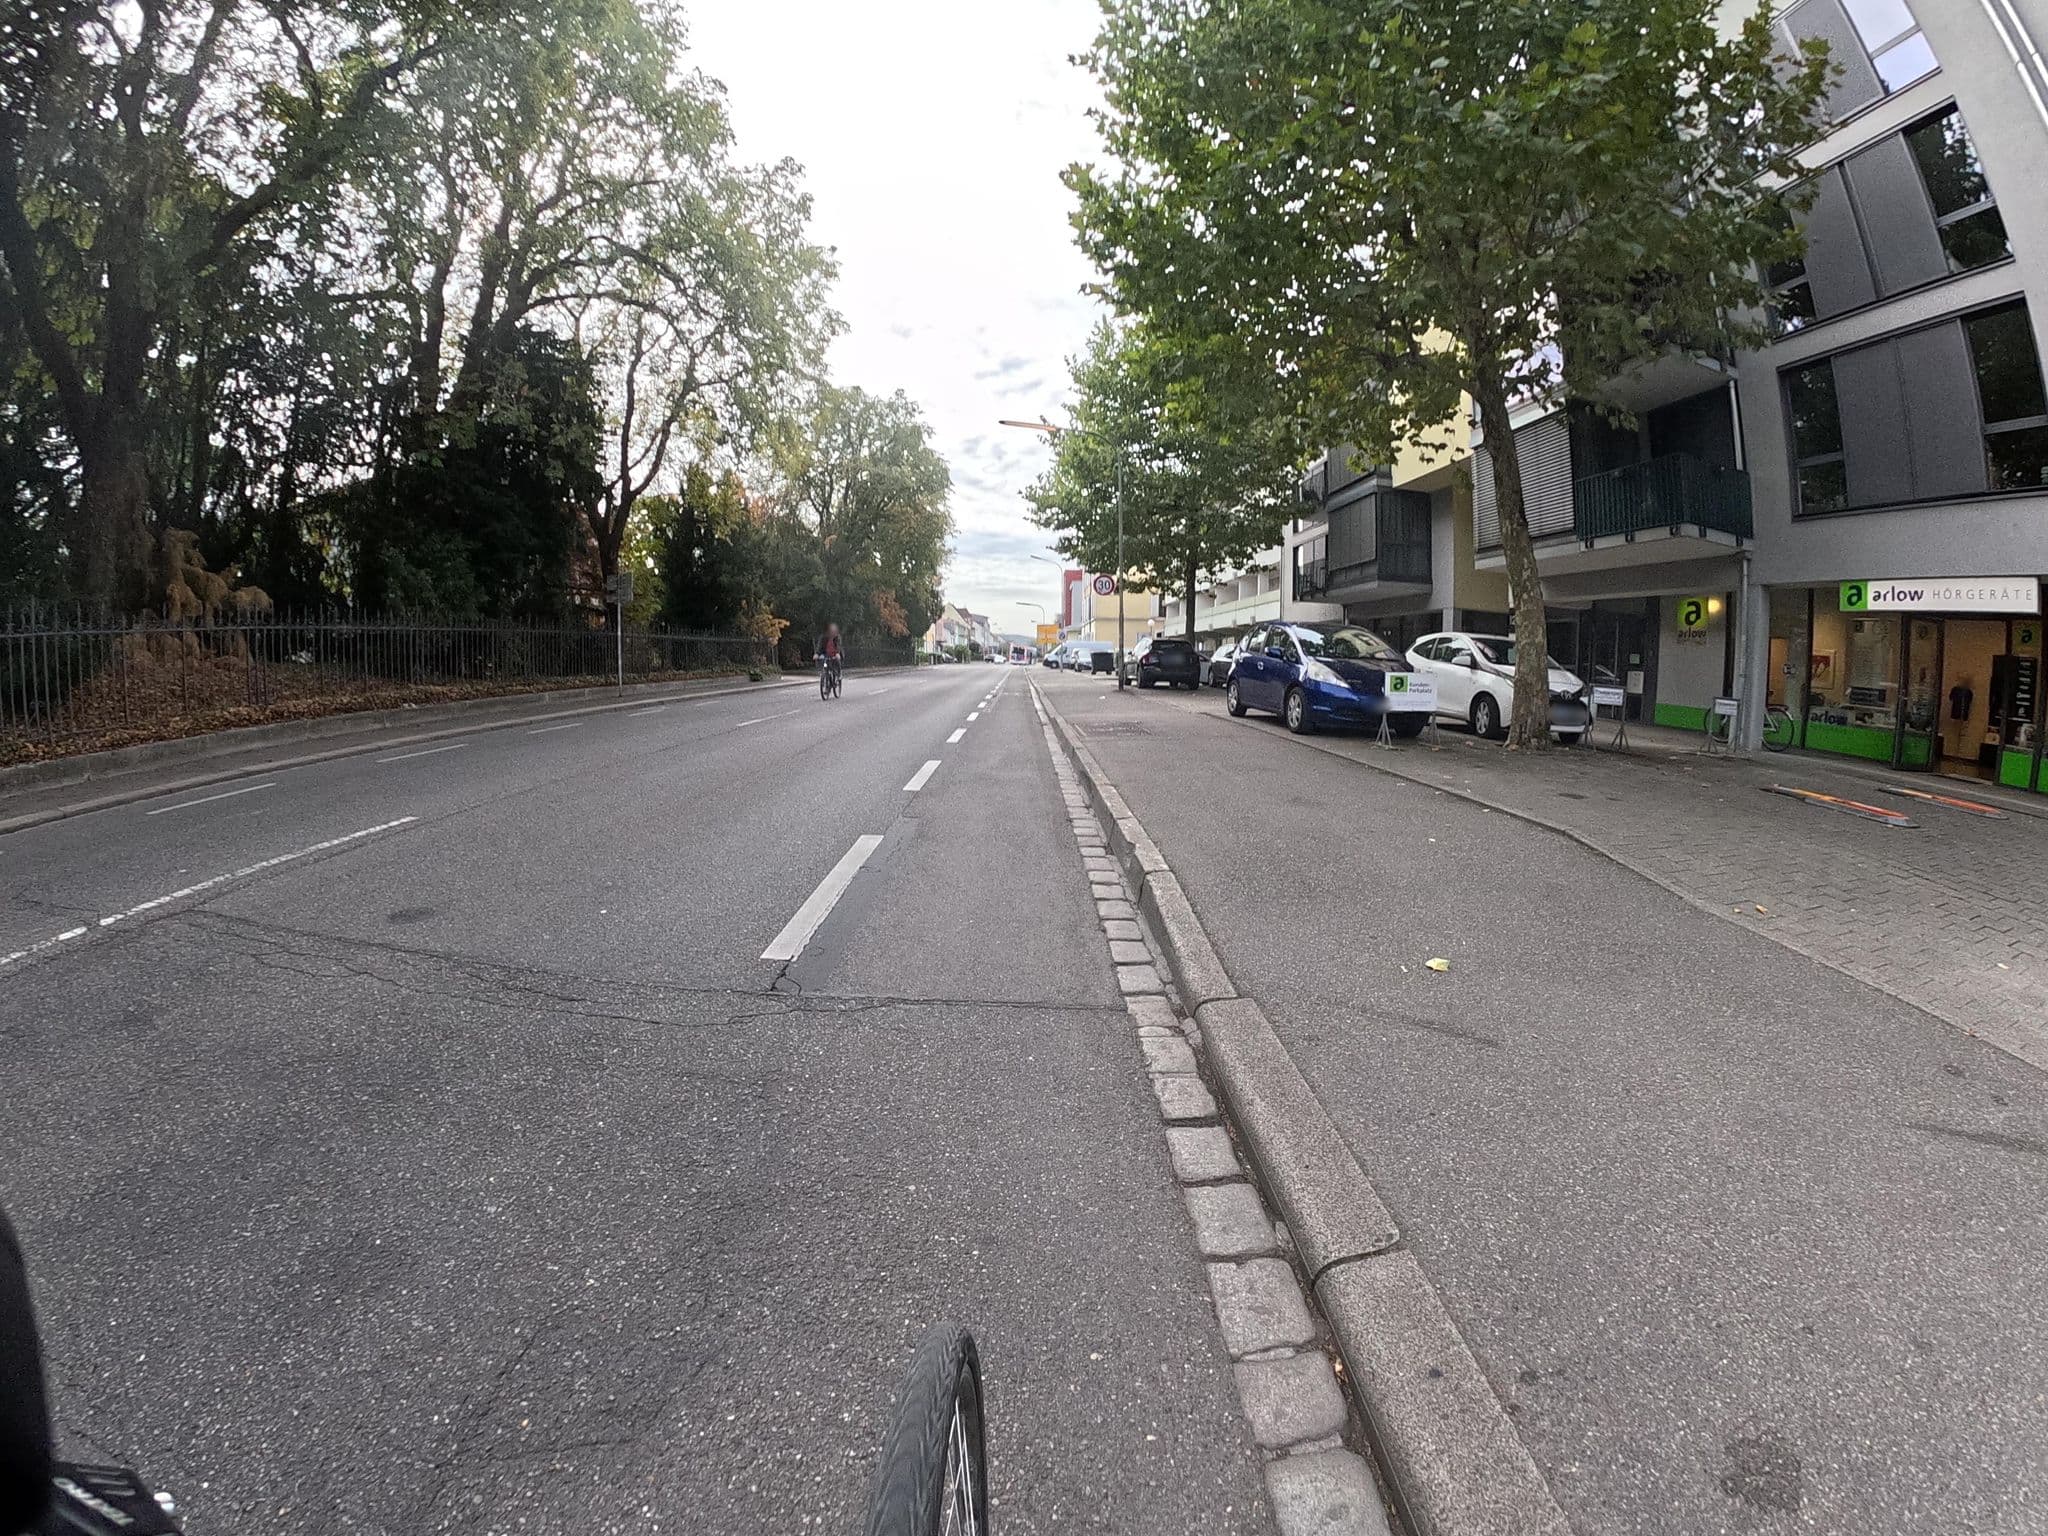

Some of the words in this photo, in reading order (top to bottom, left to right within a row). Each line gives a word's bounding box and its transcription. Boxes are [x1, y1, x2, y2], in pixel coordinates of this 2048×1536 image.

[1098, 580, 1110, 590] 30
[1846, 584, 1862, 606] a
[1872, 586, 1925, 602] arlow
[1932, 587, 2033, 601] HÖRGERÄTE
[1684, 601, 1702, 625] a
[1677, 627, 1707, 638] arlow
